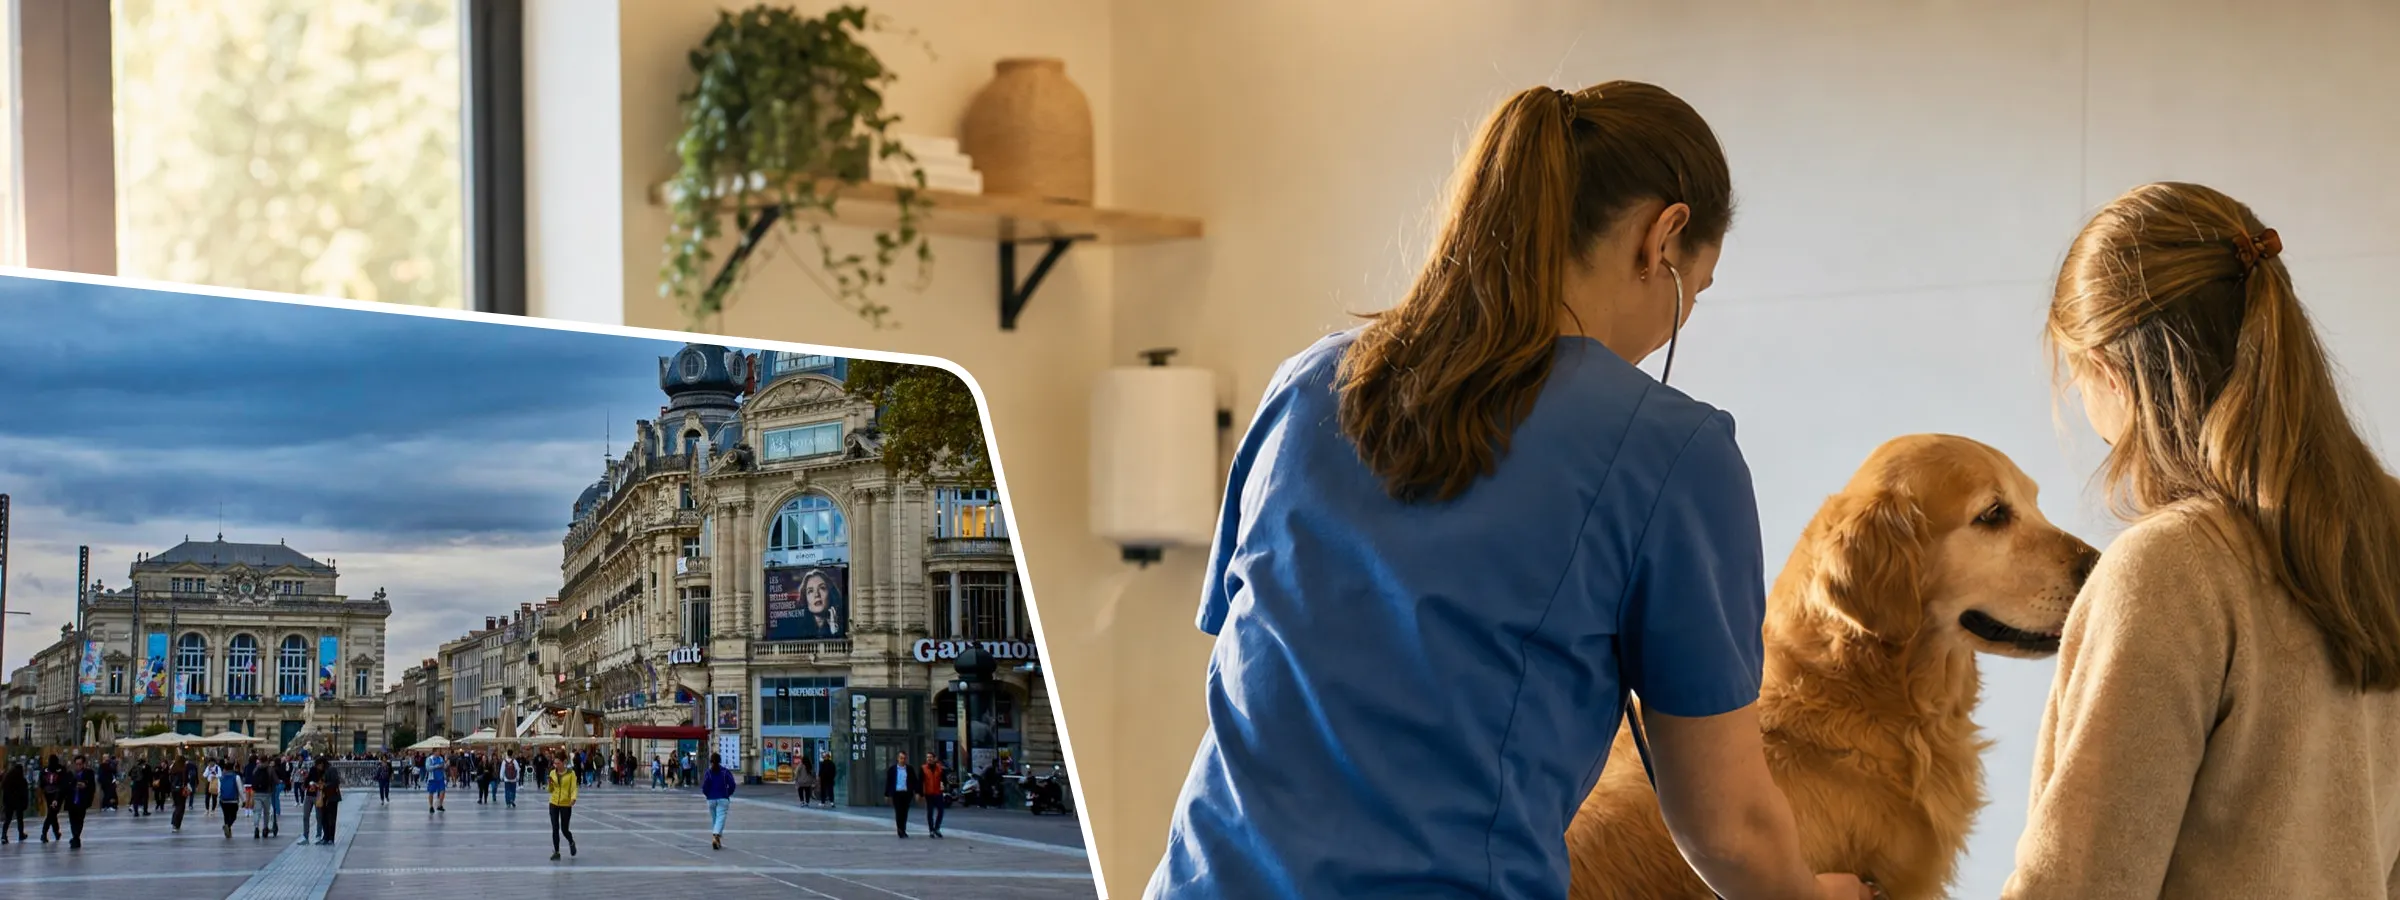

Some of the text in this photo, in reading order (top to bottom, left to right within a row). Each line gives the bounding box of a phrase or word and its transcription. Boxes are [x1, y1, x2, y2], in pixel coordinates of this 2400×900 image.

[769, 576, 779, 584] LES
[769, 584, 783, 593] PLUS
[769, 593, 788, 602] BELLES
[769, 601, 796, 611] HISTOIRES
[769, 609, 805, 619] COMMENCENT
